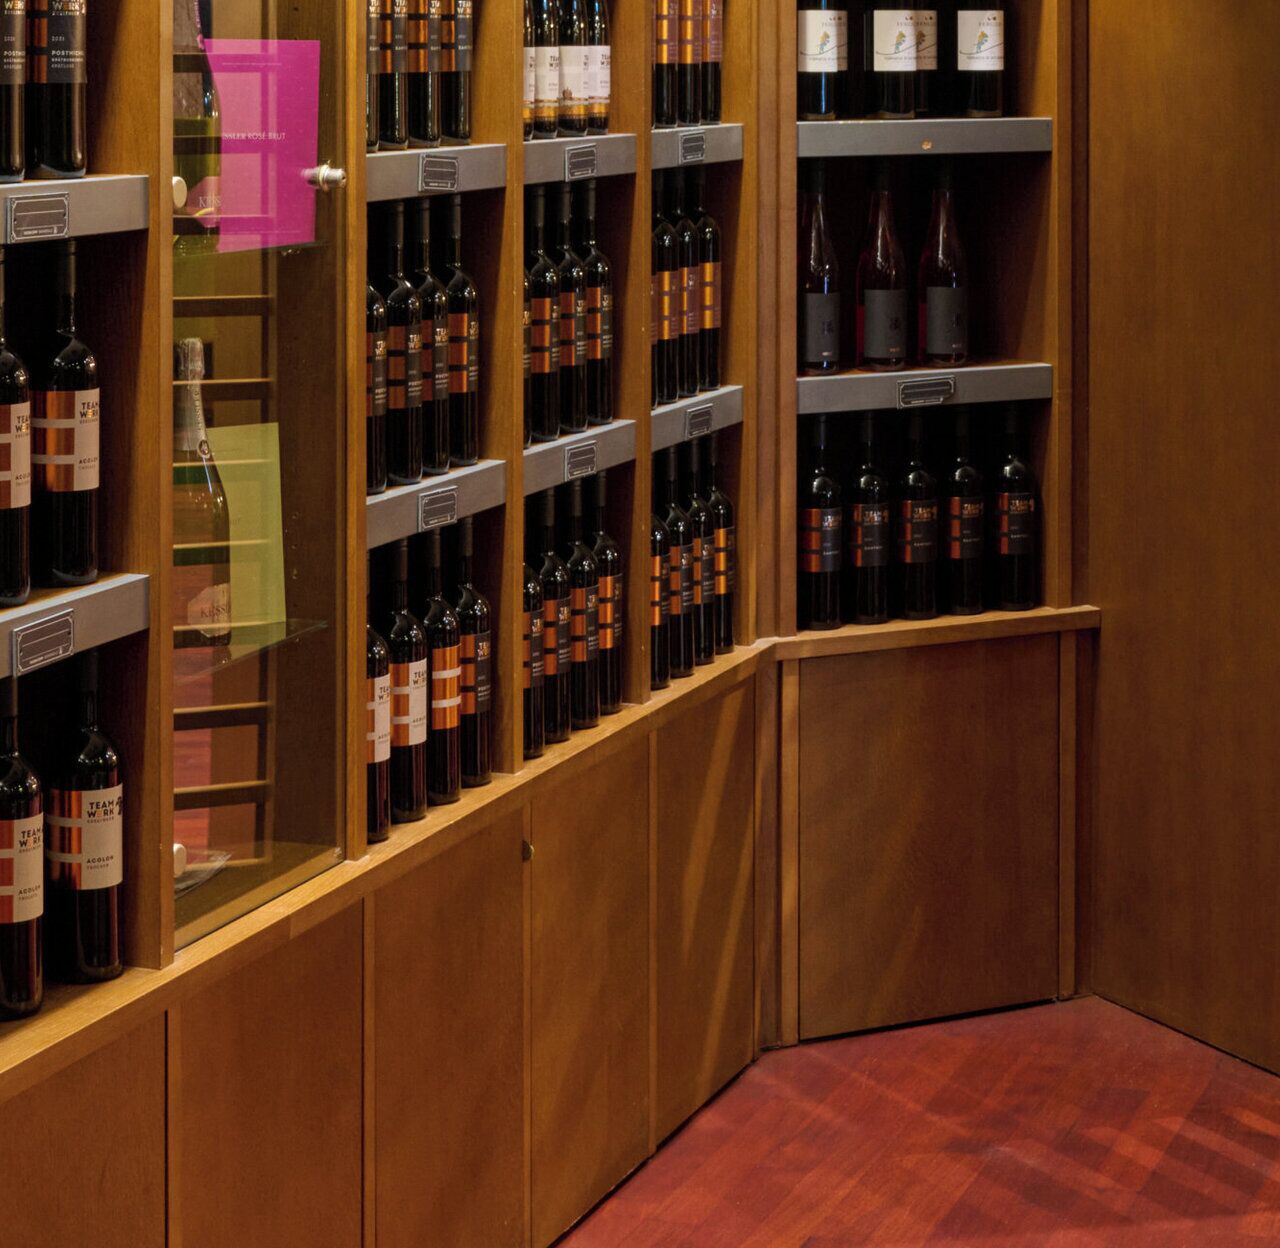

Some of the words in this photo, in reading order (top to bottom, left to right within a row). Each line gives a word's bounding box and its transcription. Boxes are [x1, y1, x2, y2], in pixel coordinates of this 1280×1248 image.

[89, 800, 114, 810] TEAM
[87, 808, 114, 819] WERK
[86, 855, 114, 864] ACOLON
